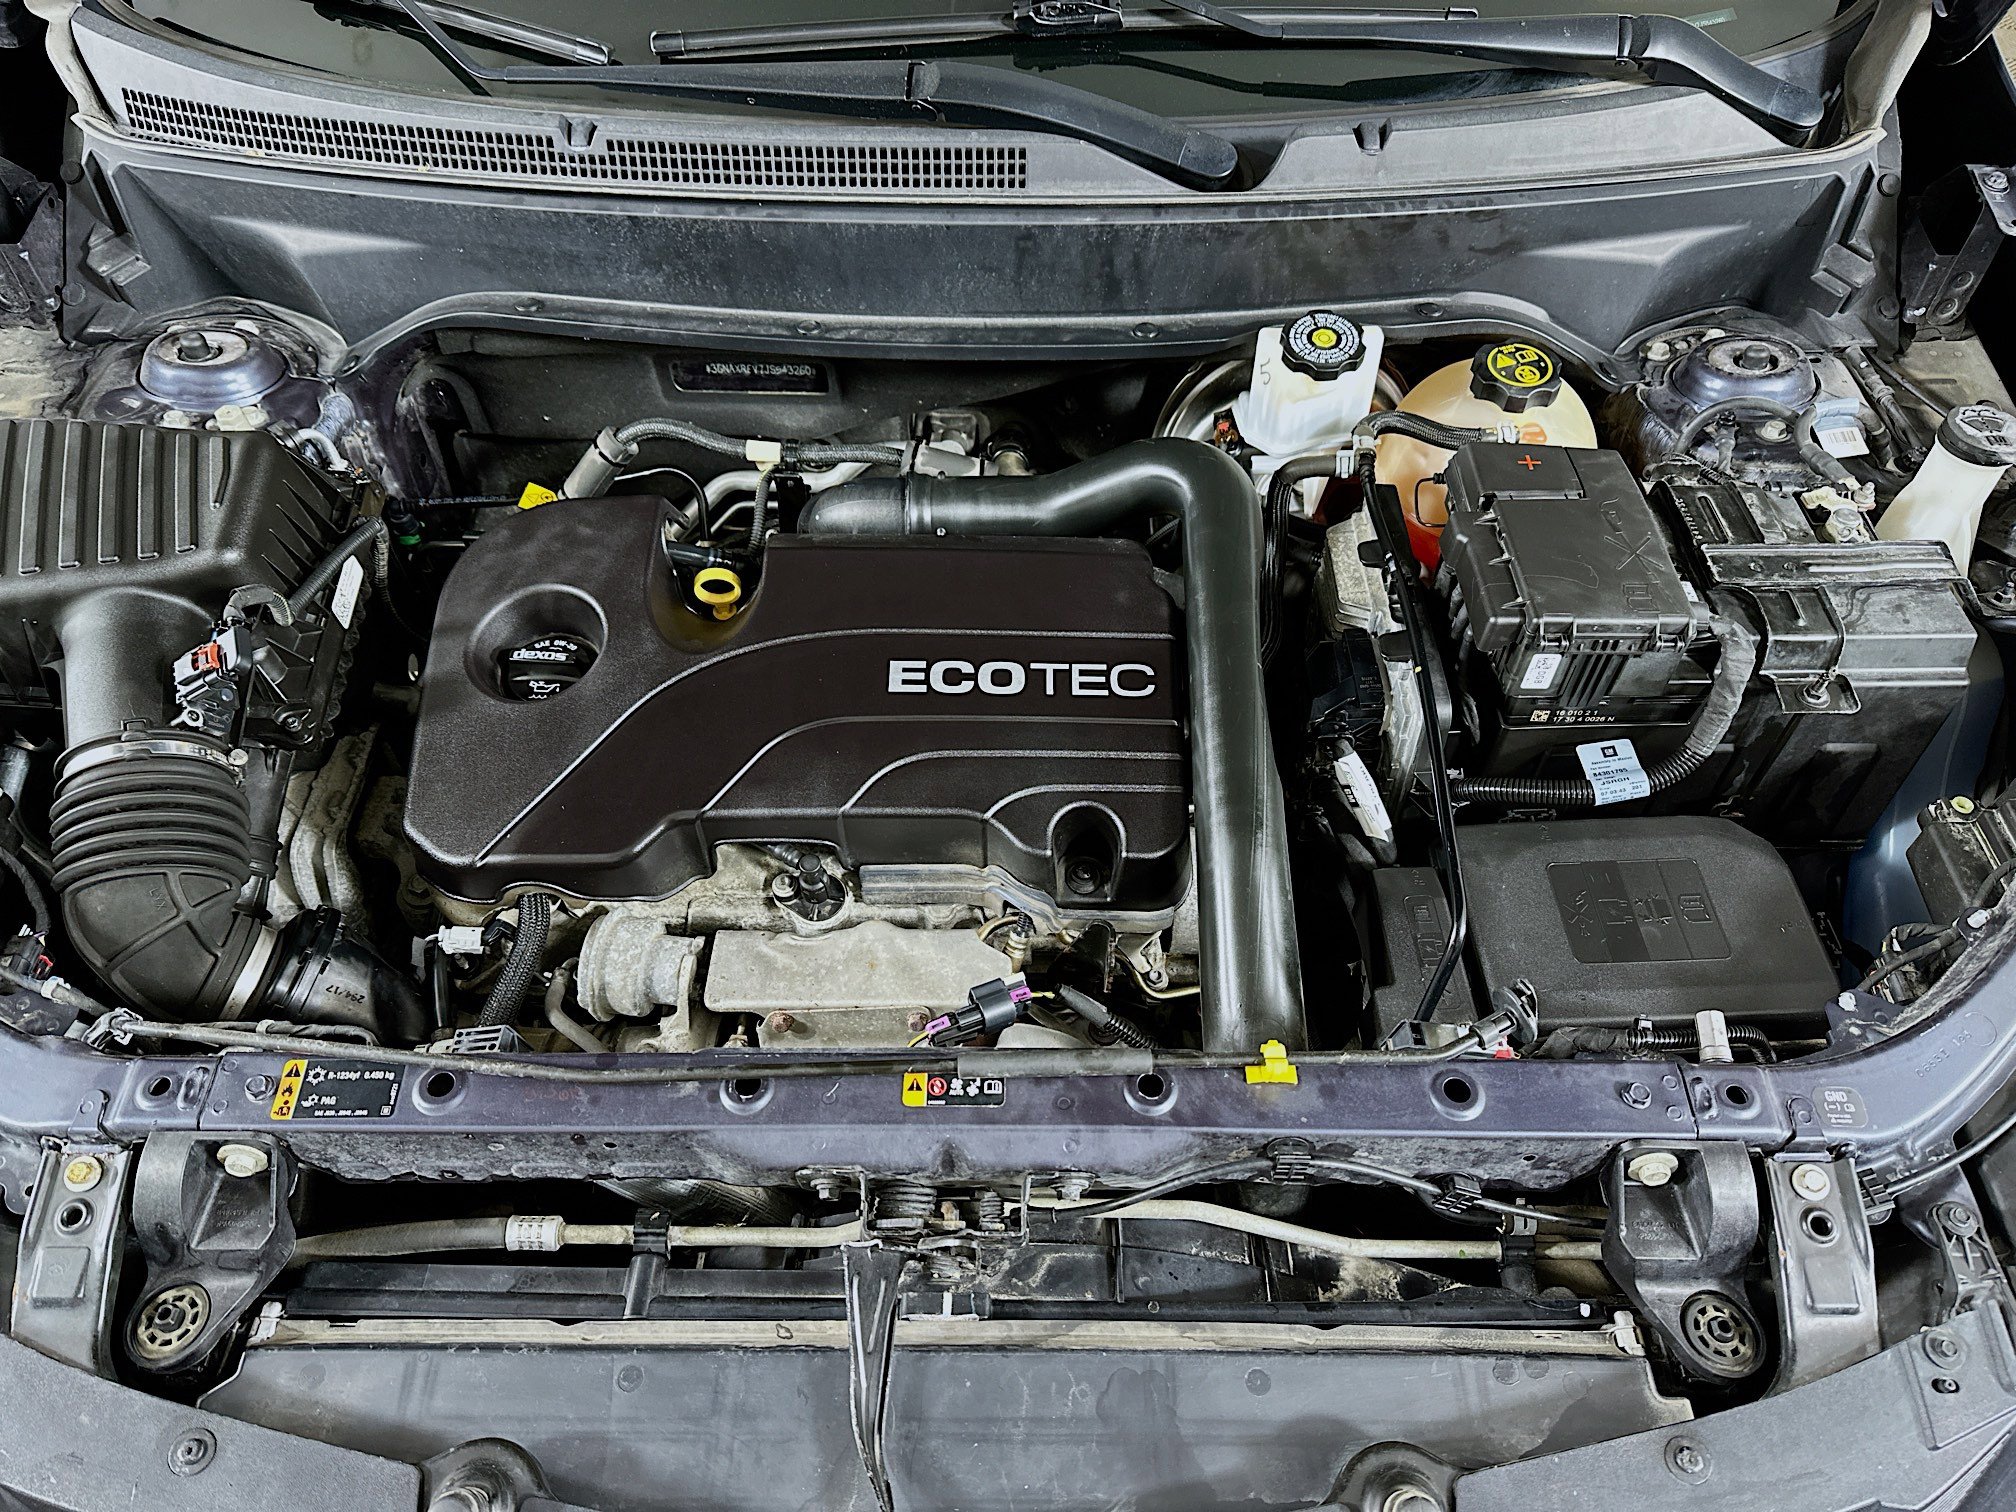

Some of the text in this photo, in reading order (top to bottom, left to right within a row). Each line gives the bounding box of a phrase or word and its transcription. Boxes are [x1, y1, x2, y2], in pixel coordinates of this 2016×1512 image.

[534, 640, 551, 649] SAE
[512, 648, 569, 662] dexos
[888, 660, 1156, 697] ECOTEC
[320, 1095, 337, 1105] PAG
[1824, 1090, 1848, 1102] GND
